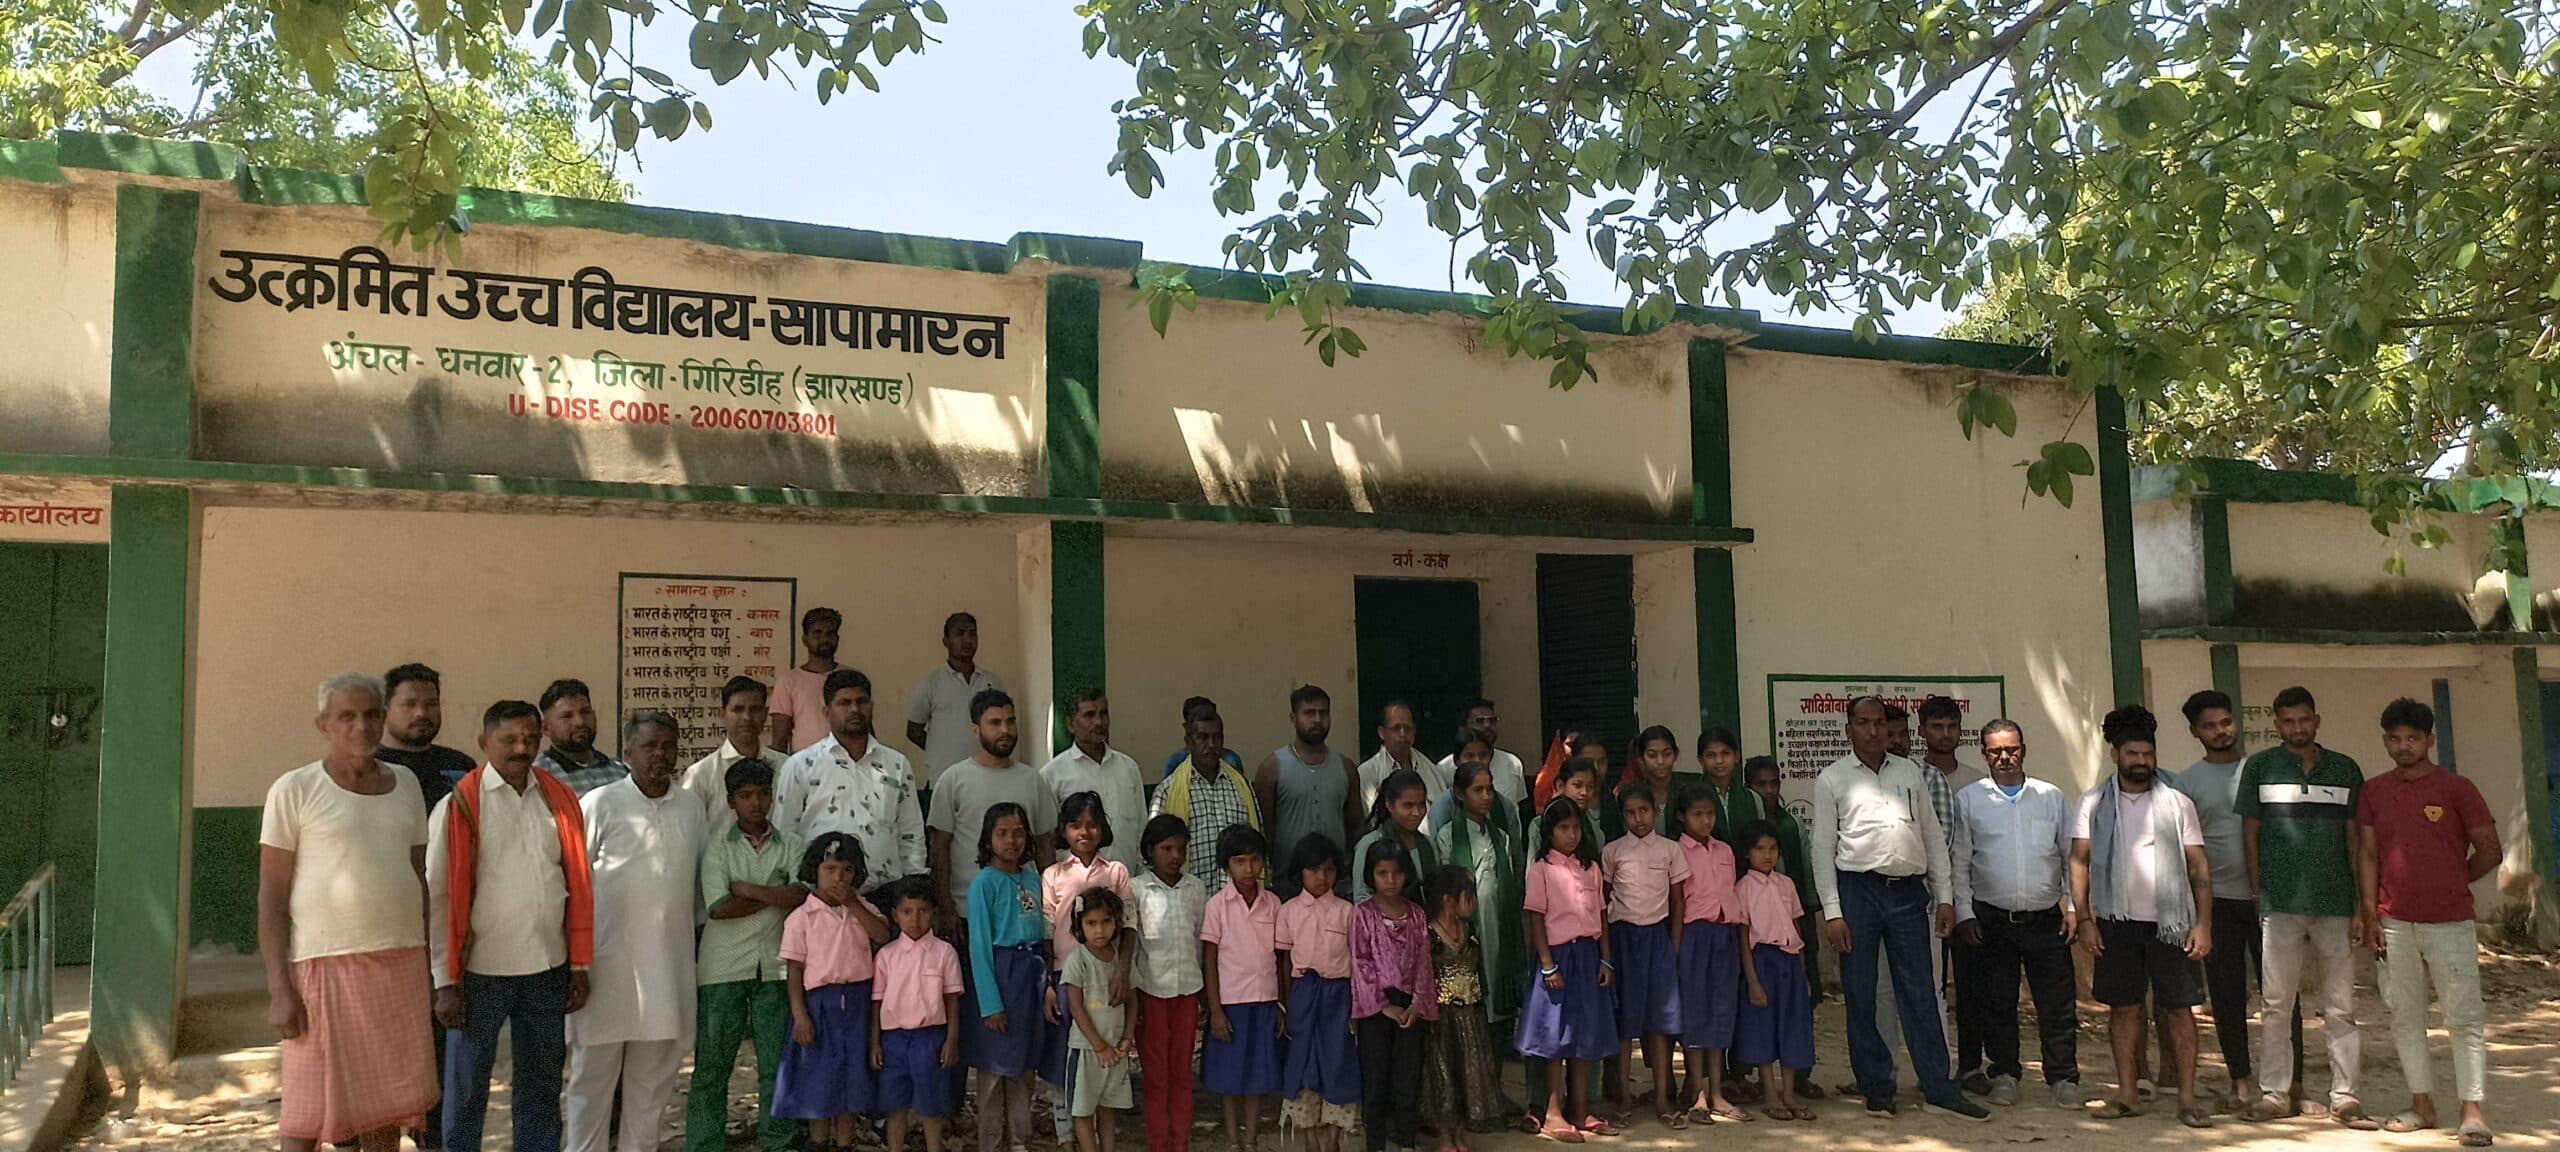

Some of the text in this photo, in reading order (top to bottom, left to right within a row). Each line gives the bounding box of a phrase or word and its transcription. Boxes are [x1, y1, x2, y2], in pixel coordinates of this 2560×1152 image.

[208, 246, 435, 317] उत्क्रमित
[437, 268, 565, 328] उच्च
[691, 405, 837, 436] 20060703801
[666, 585, 736, 600] सामान्य ज्ञान
[632, 607, 660, 621] भारत
[661, 604, 671, 620] के
[672, 603, 708, 624] राष्ट्रीय
[710, 608, 732, 624] फूल
[746, 609, 780, 620] कमल
[632, 627, 659, 640] भारत
[660, 624, 670, 638] के
[672, 624, 706, 641] राष्ट्रीय
[711, 627, 730, 643] पशु
[632, 646, 660, 659] भारत
[662, 642, 671, 657] के
[673, 642, 707, 660] राष्ट्रीय
[632, 666, 661, 679] भारत
[662, 663, 672, 678] के
[673, 663, 707, 683] राष्ट्रीय
[633, 687, 659, 701] भारत
[660, 684, 671, 699] के
[672, 681, 707, 701] राष्ट्रीय
